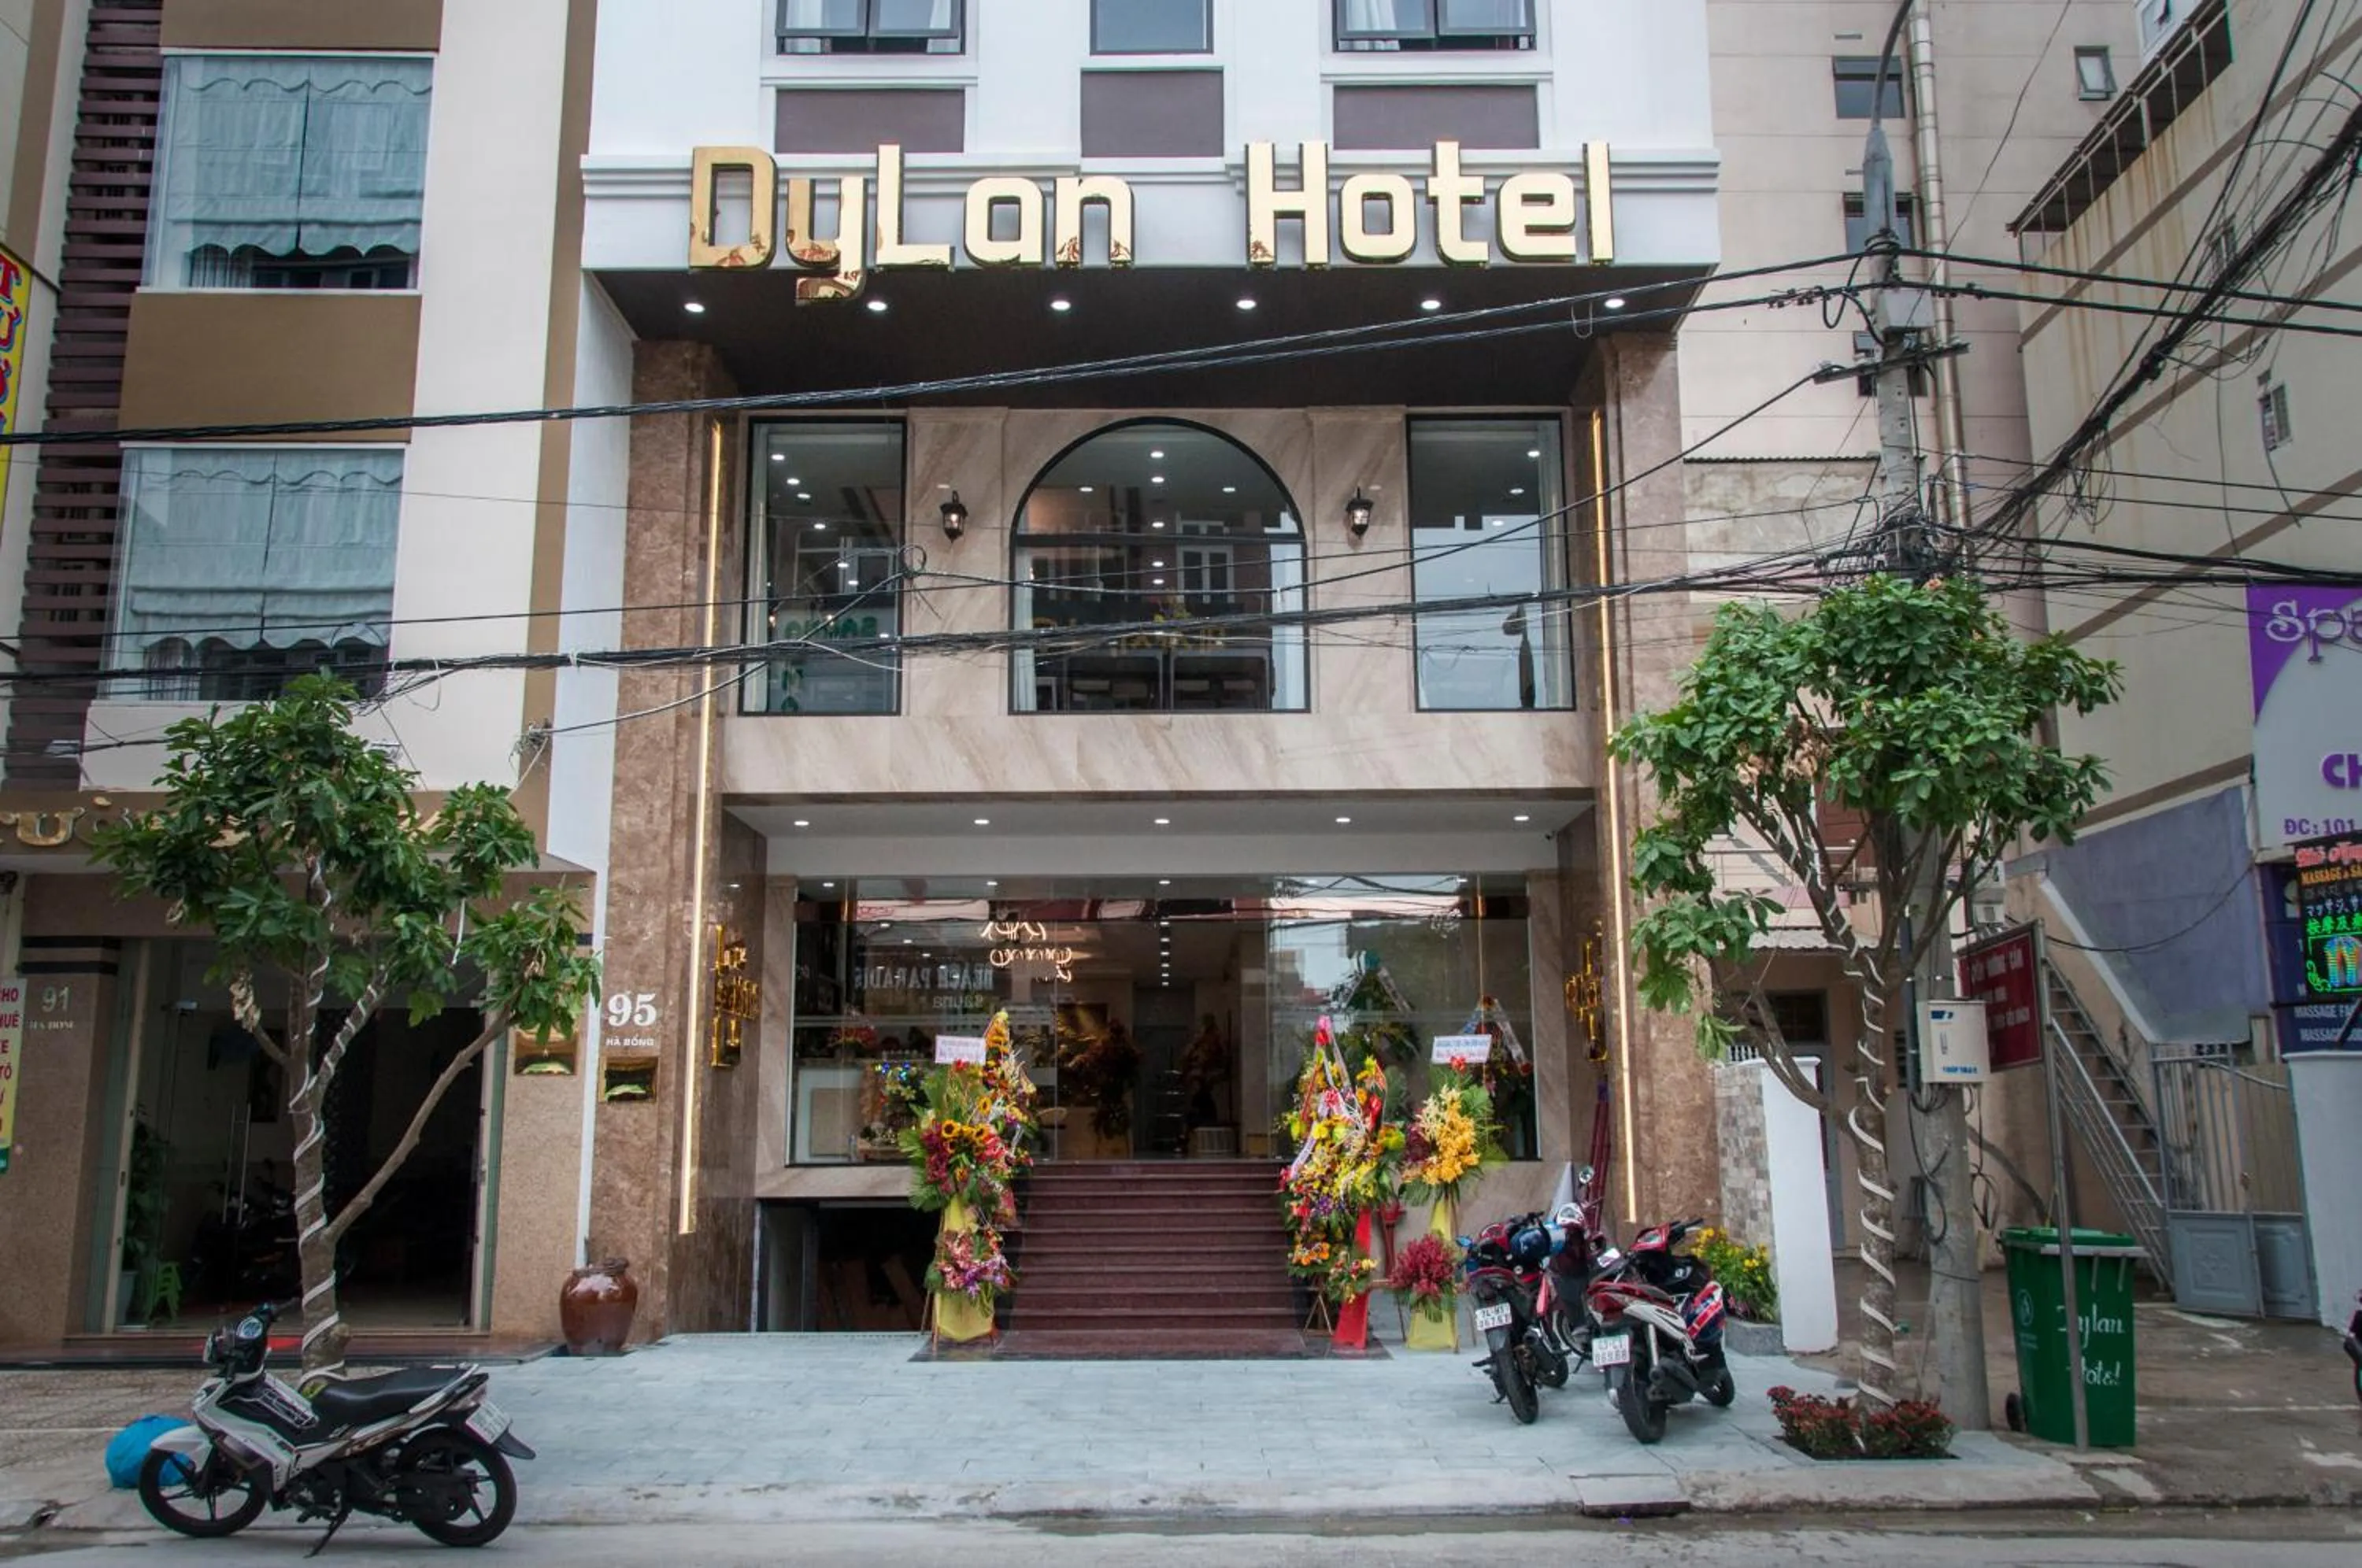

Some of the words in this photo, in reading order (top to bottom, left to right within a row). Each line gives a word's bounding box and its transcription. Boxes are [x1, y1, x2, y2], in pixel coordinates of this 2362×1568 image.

[1244, 140, 1616, 269] Hotel
[42, 986, 69, 1013] 91
[608, 993, 657, 1027] 95
